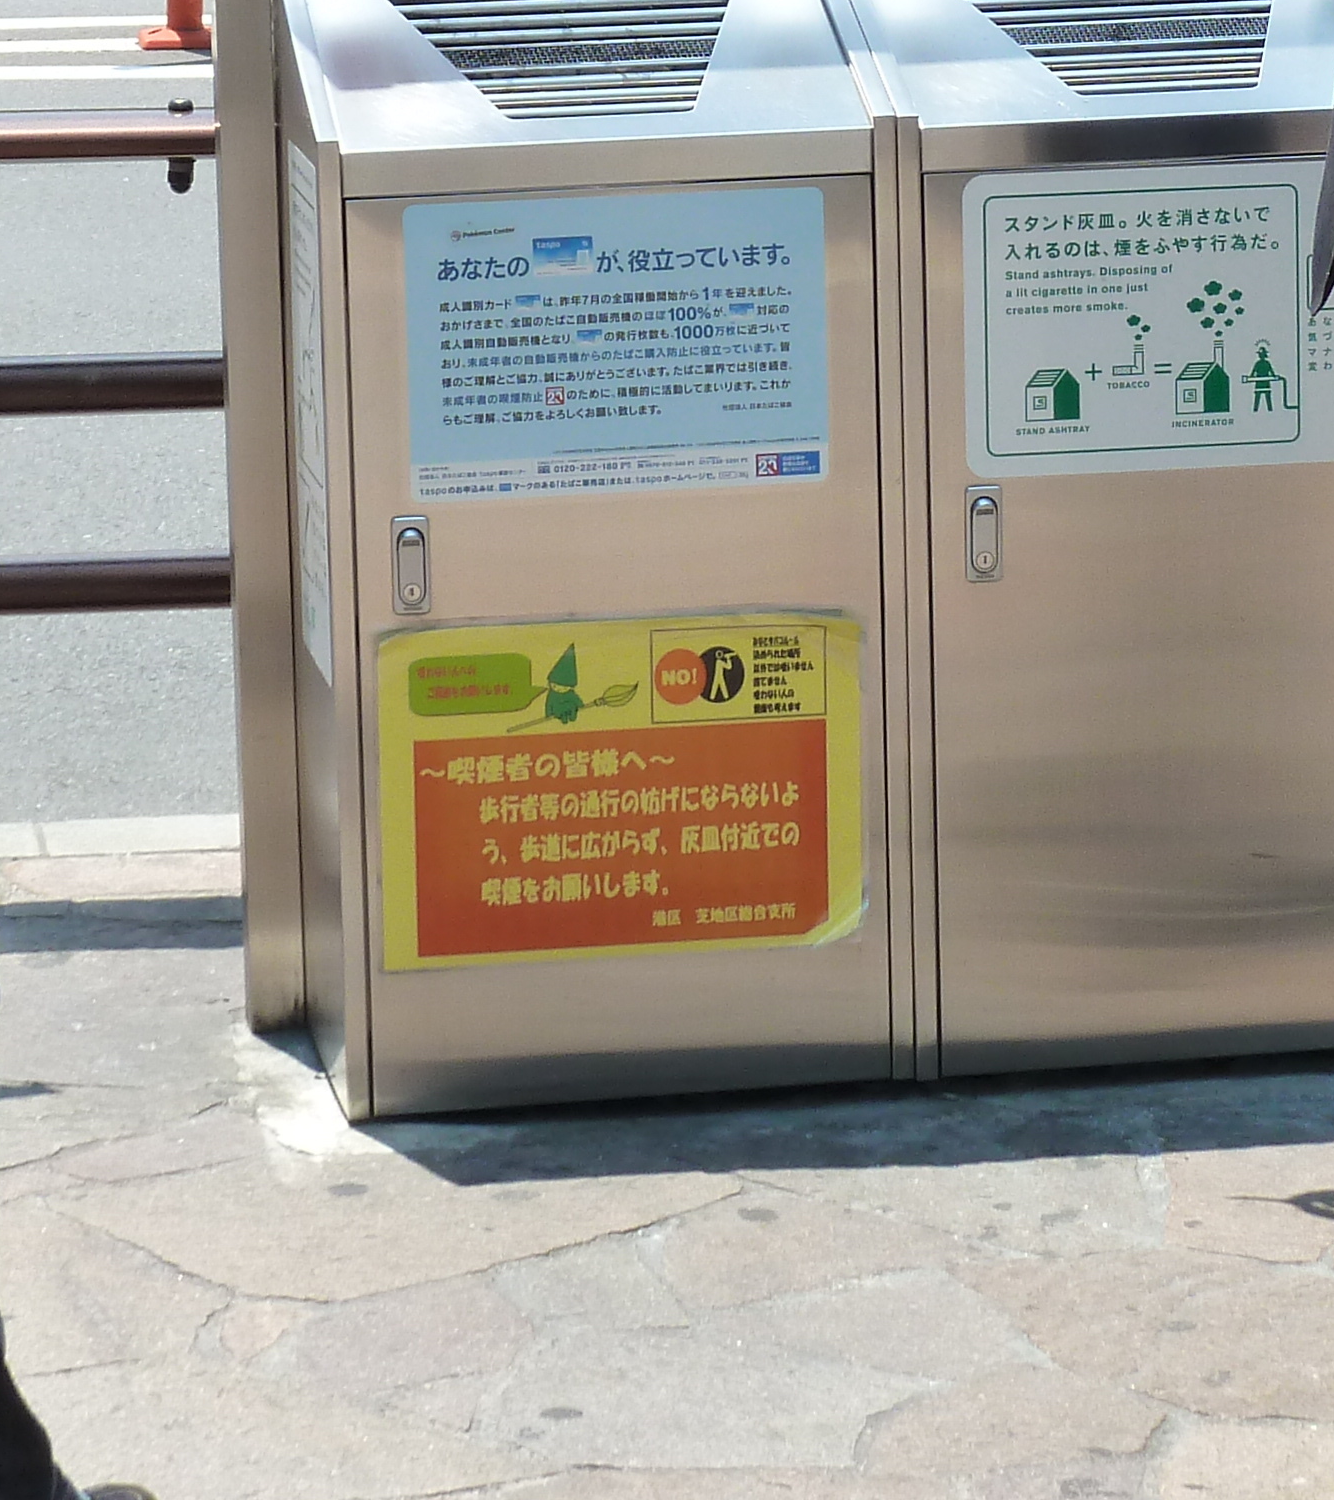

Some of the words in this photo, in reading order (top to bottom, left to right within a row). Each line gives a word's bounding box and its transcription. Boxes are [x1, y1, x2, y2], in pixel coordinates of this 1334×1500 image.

[1004, 233, 1280, 261] 入れるのは、煙をふやす行為だ。
[437, 256, 530, 282] あなたの
[596, 243, 791, 273] が、役立っています。
[1005, 269, 1039, 281] Stand
[1042, 267, 1095, 279] ashtrays.
[1099, 265, 1157, 277] Disposing
[1161, 264, 1173, 274] of
[1005, 290, 1012, 298] a
[1016, 287, 1028, 297] lit
[1031, 285, 1083, 298] cigarette
[1087, 284, 1098, 295] in
[1101, 285, 1123, 294] one
[1126, 282, 1148, 295] just
[1005, 304, 1049, 315] creates
[1052, 304, 1082, 313] more
[1086, 301, 1129, 312] smoke.
[1107, 380, 1150, 390] TOBACCO
[1015, 427, 1046, 436] STAND
[1048, 425, 1091, 434] ASHTRAY
[1171, 418, 1235, 428] INCINERATOR
[660, 667, 698, 687] NO!
[652, 908, 682, 928] 港区
